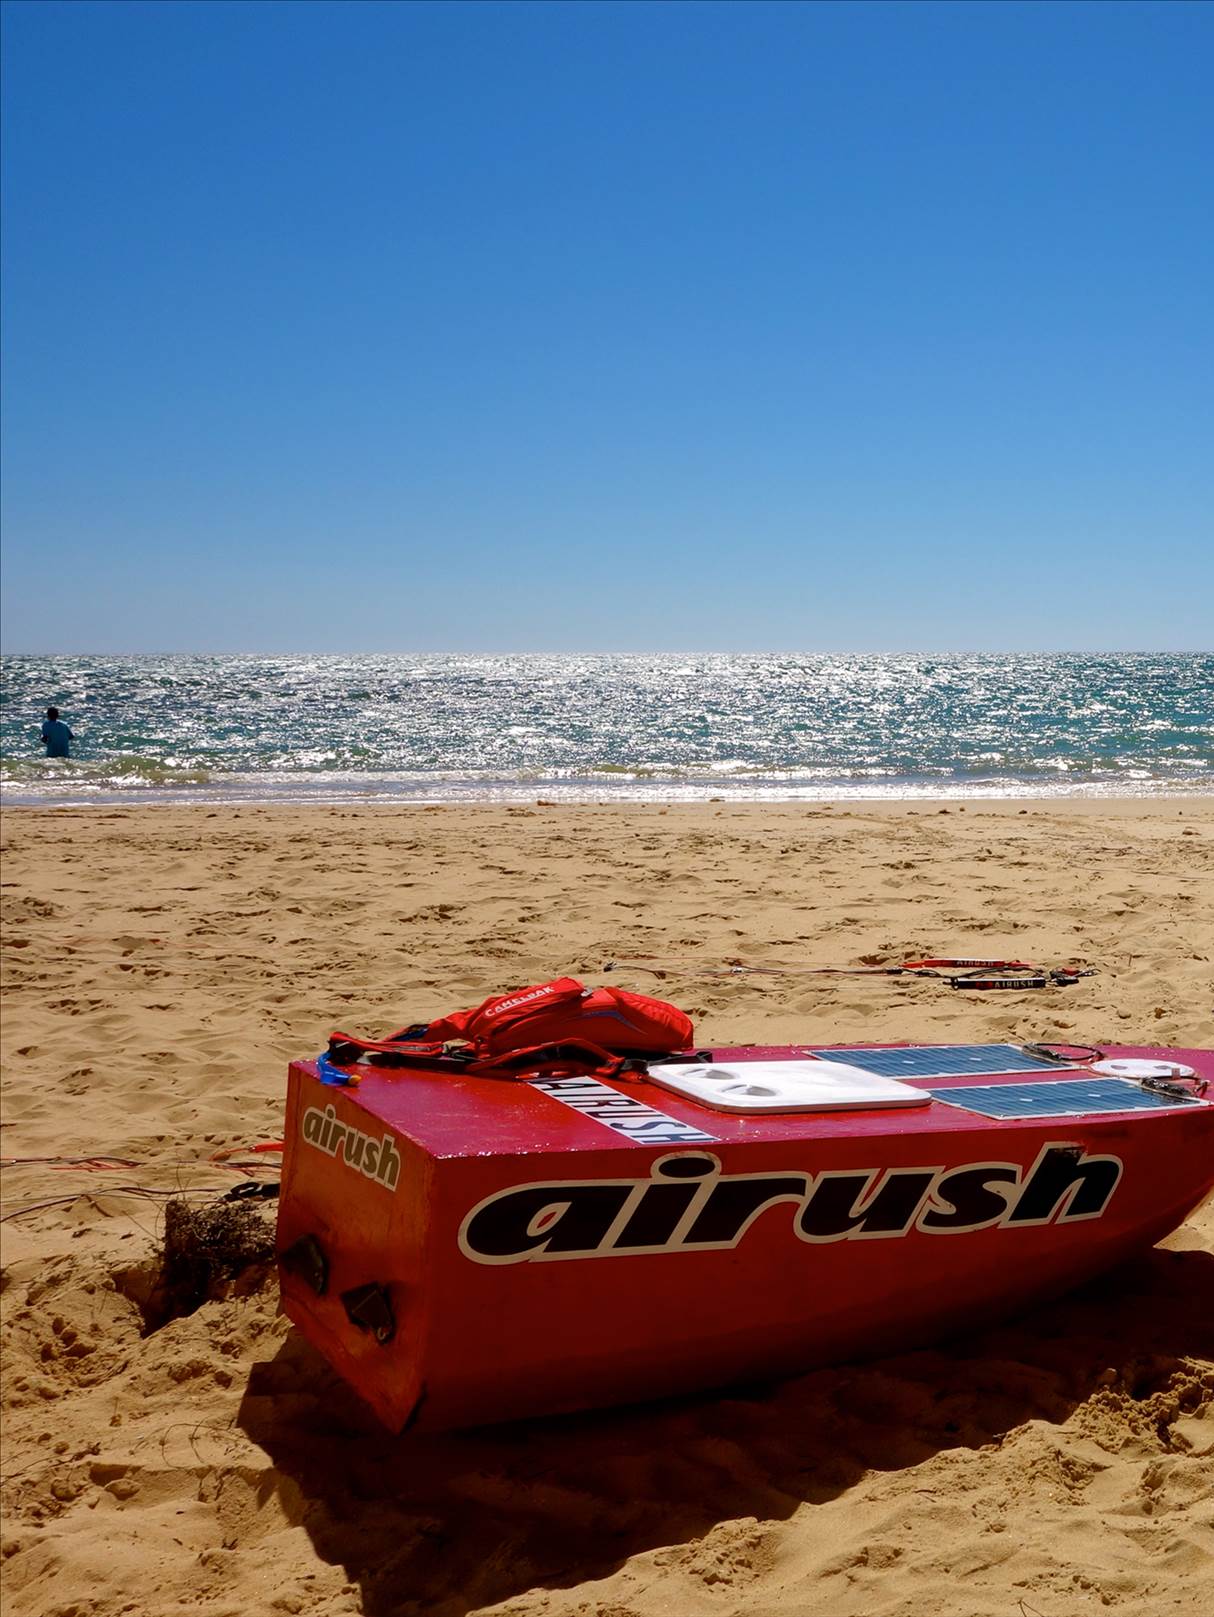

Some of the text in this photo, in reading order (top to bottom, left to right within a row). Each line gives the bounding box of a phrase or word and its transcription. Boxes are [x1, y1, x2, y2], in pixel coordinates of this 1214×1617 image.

[994, 979, 1034, 989] AIRUSH
[302, 1104, 401, 1192] airush
[530, 1079, 719, 1143] AIRUSH
[457, 1140, 1125, 1266] airush
